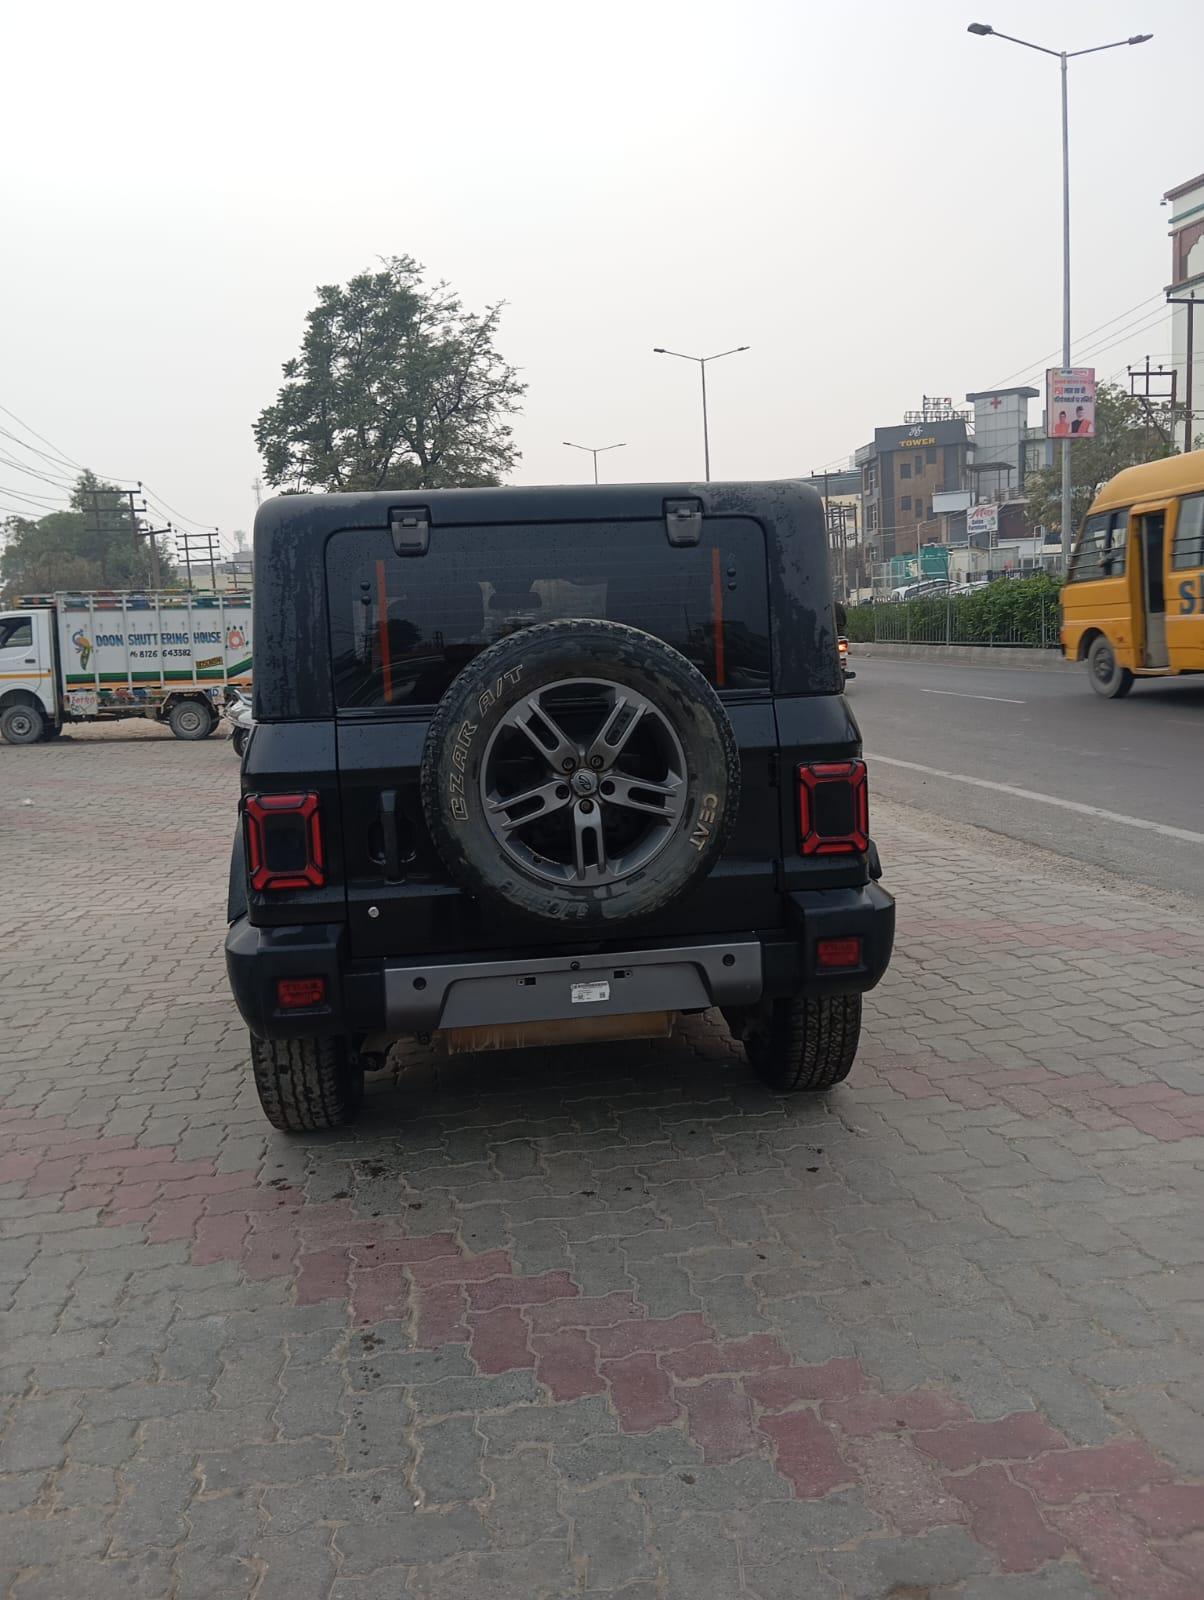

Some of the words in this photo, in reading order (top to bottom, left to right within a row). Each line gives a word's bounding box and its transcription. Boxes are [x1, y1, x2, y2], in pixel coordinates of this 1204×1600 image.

[899, 437, 936, 447] TOWER
[96, 634, 124, 647] DOON
[193, 632, 221, 644] HOUSE
[450, 720, 478, 820] CZAR
[478, 664, 523, 718] A/T
[690, 793, 718, 850] CEAT
